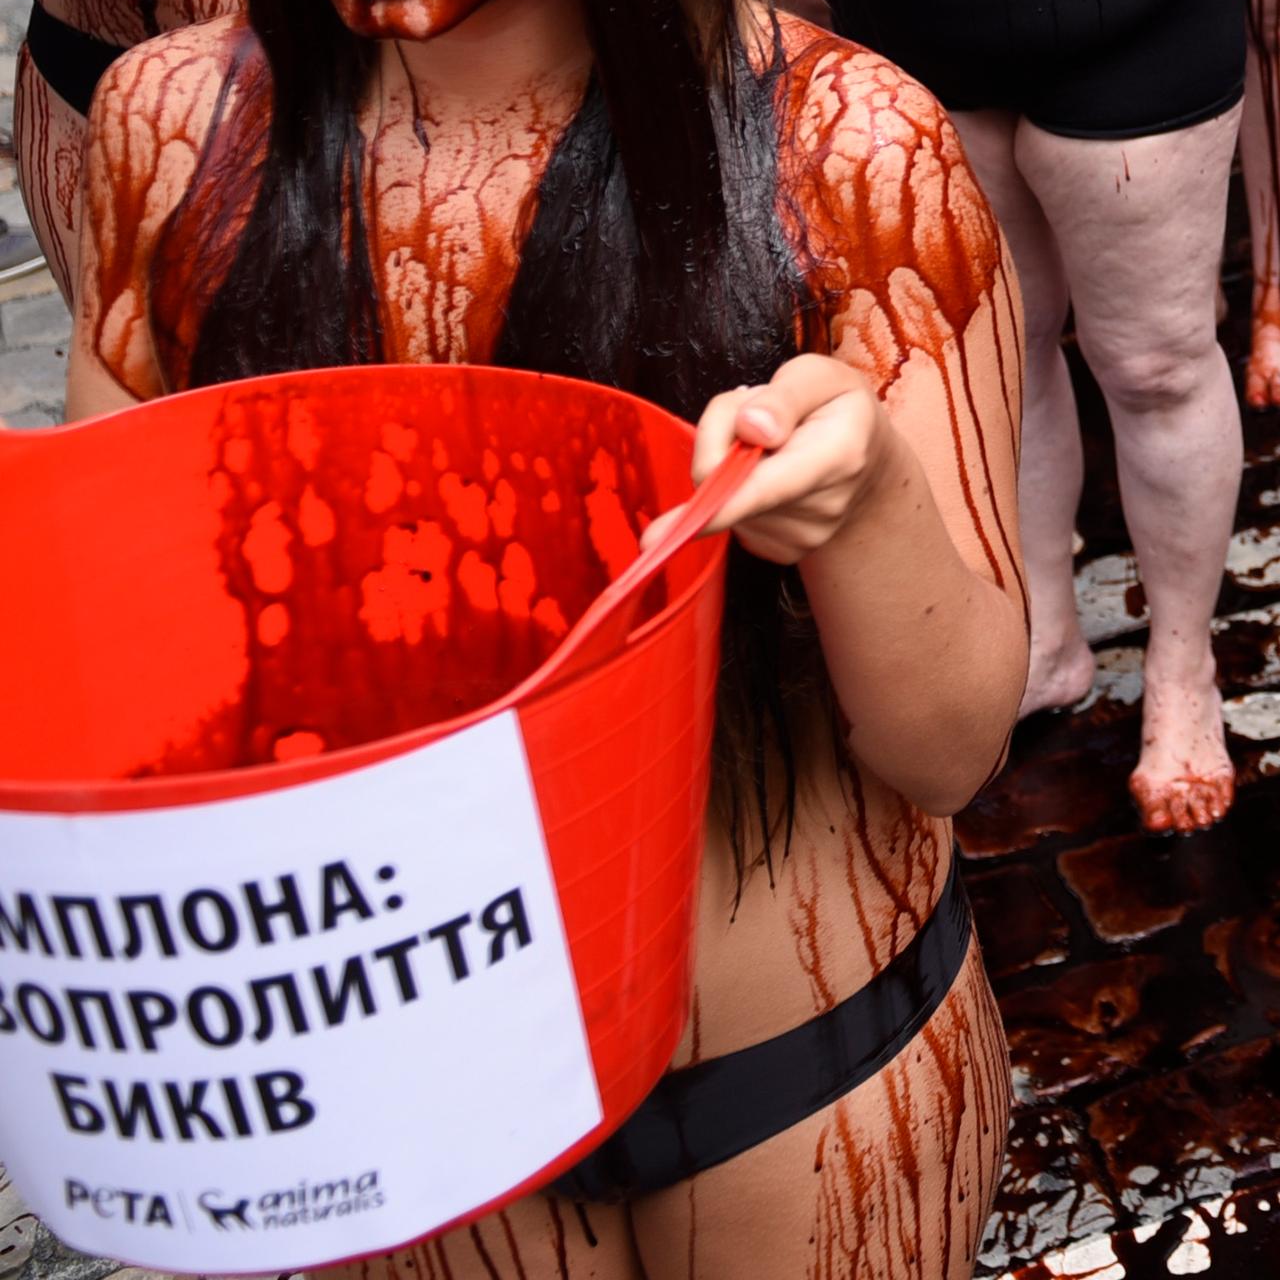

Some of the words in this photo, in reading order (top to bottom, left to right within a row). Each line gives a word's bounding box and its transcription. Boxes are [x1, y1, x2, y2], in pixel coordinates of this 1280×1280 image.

[0, 859, 406, 961] МПЛОНА:
[0, 887, 535, 1055] ОПРОЛИТТЯ
[49, 1069, 317, 1144] БИКІВ
[261, 1190, 386, 1232] naturalis
